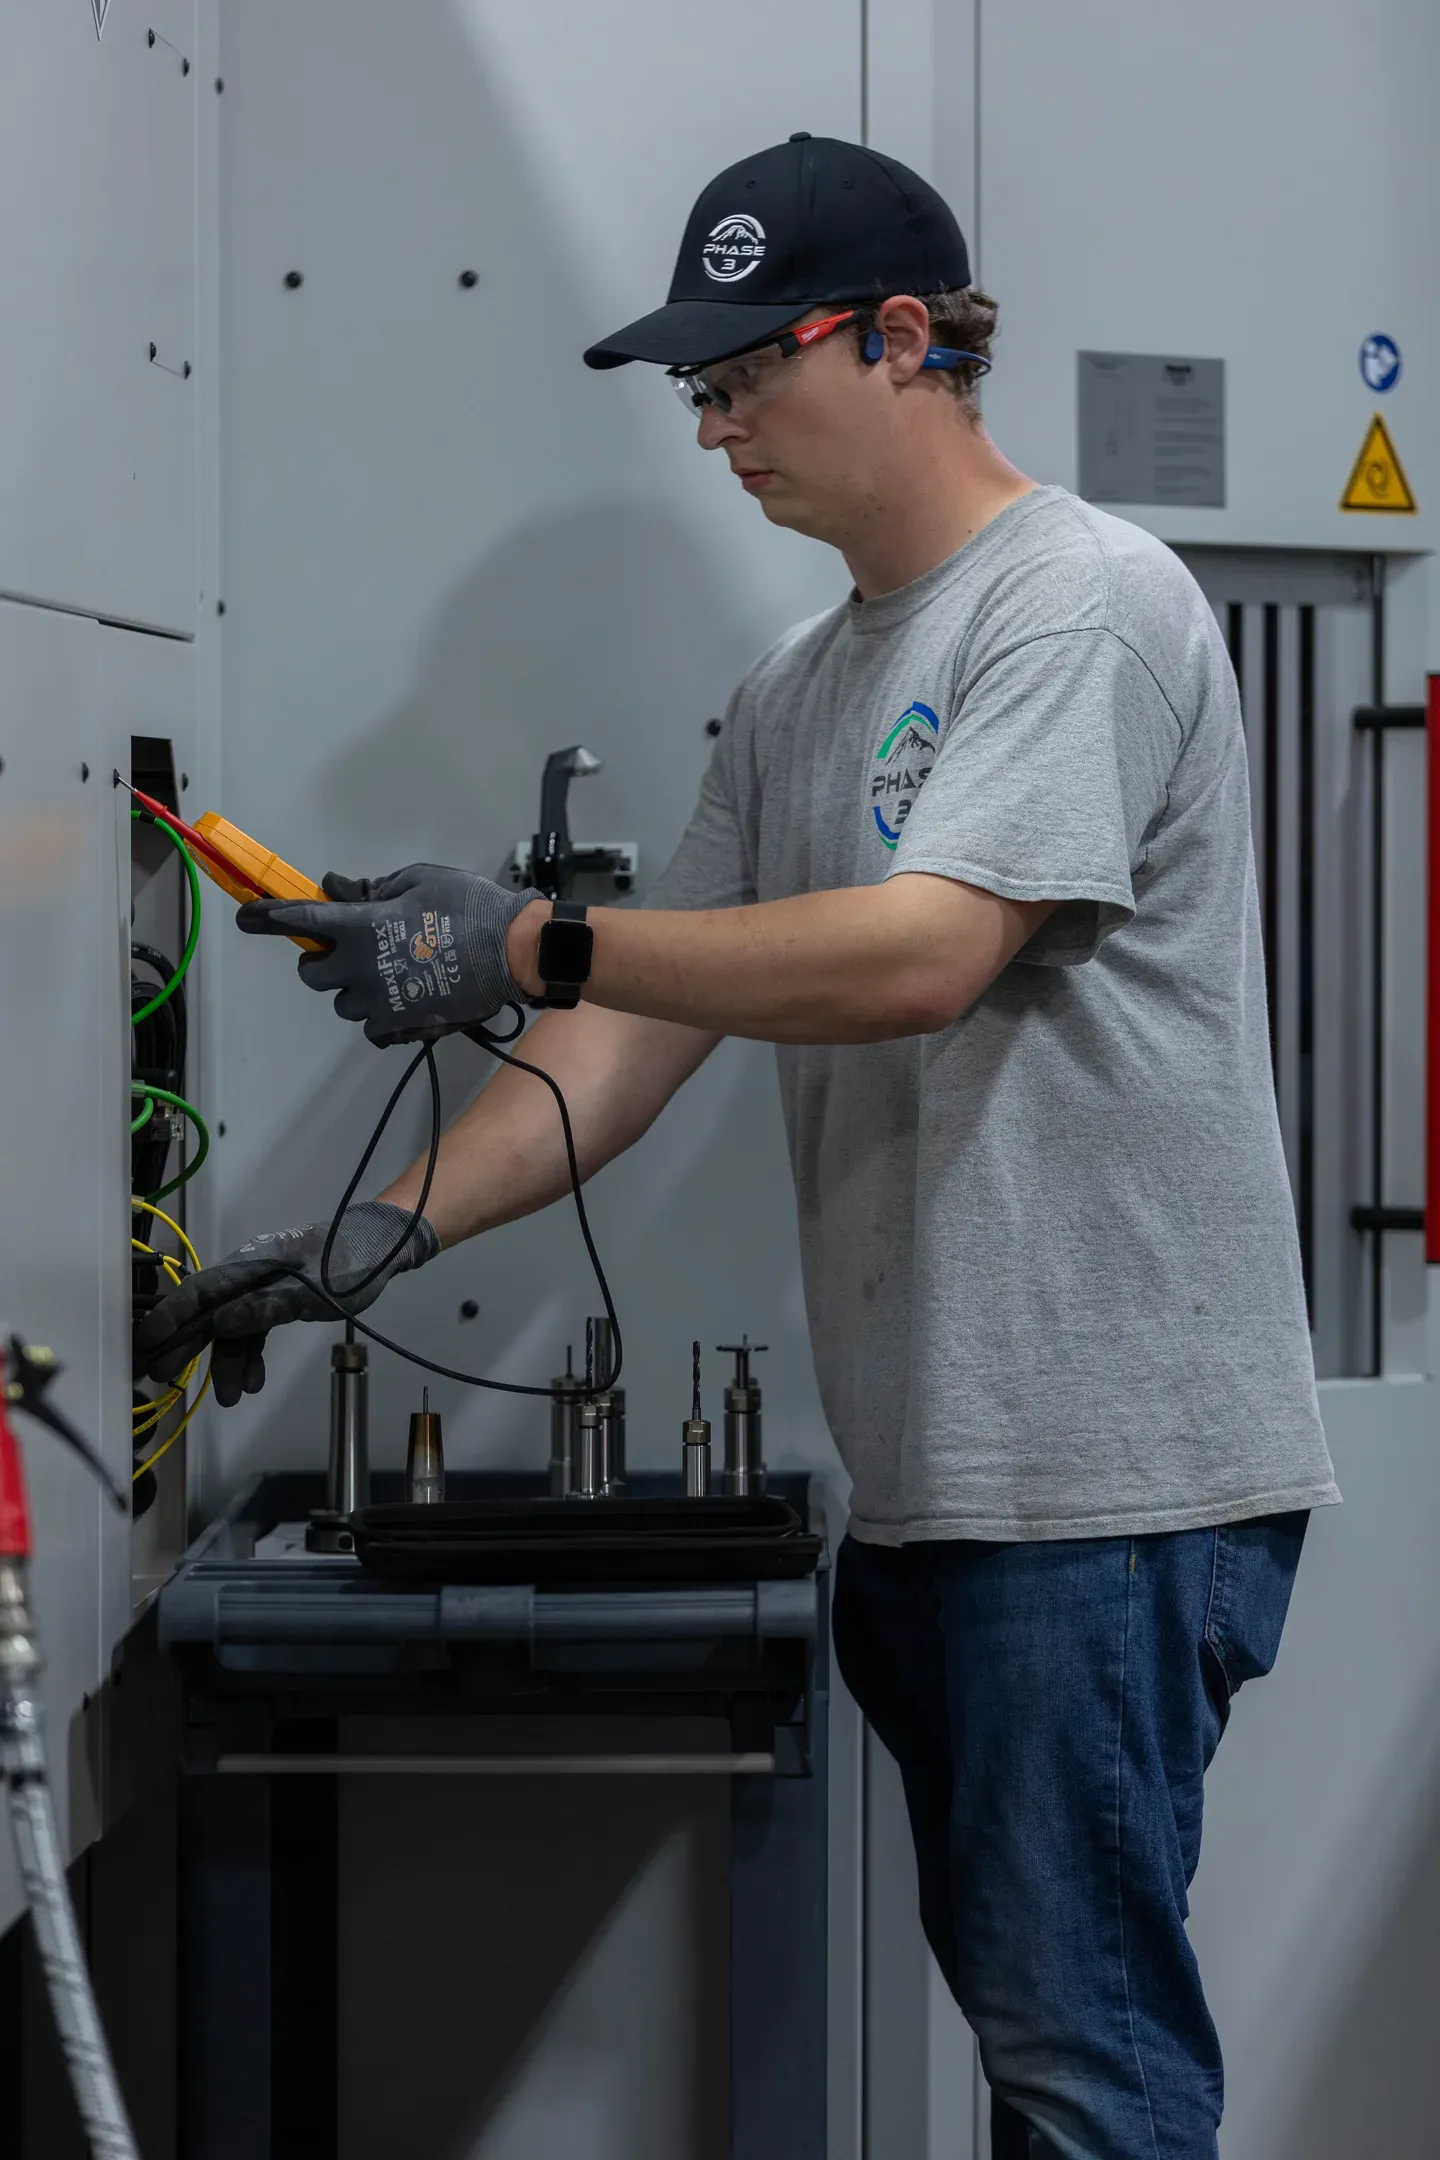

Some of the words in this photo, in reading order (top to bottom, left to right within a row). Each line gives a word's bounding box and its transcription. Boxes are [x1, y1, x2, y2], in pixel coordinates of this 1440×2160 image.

[703, 244, 766, 256] PHASE
[720, 258, 736, 270] 3
[872, 767, 932, 797] PHAS
[894, 799, 911, 825] 3
[376, 924, 405, 1012] MaxiFlex
